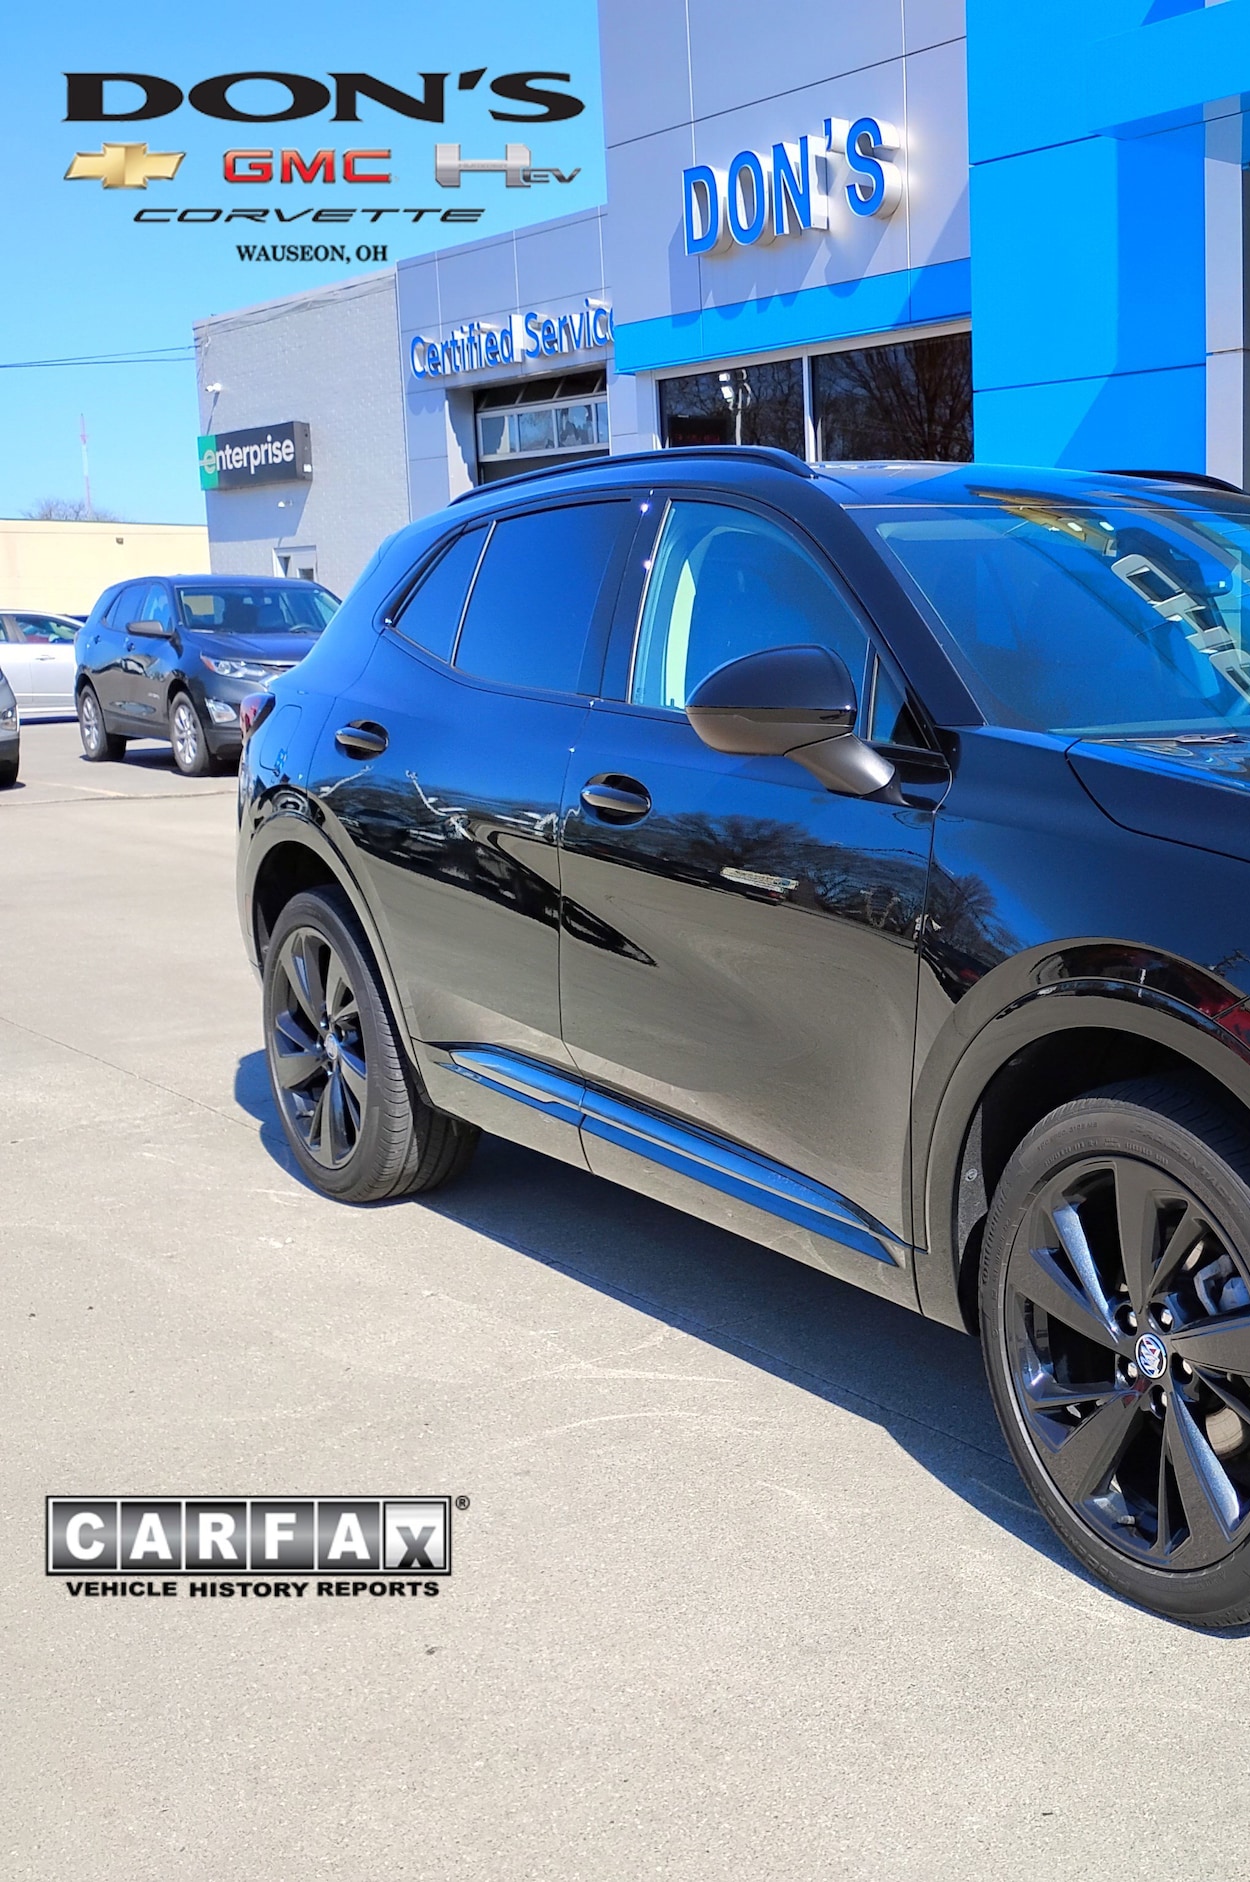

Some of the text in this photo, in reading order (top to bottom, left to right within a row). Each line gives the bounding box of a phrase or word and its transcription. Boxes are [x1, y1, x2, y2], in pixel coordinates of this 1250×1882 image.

[682, 116, 897, 257] DON'S
[410, 314, 520, 379] Certified
[202, 433, 295, 475] enterprise
